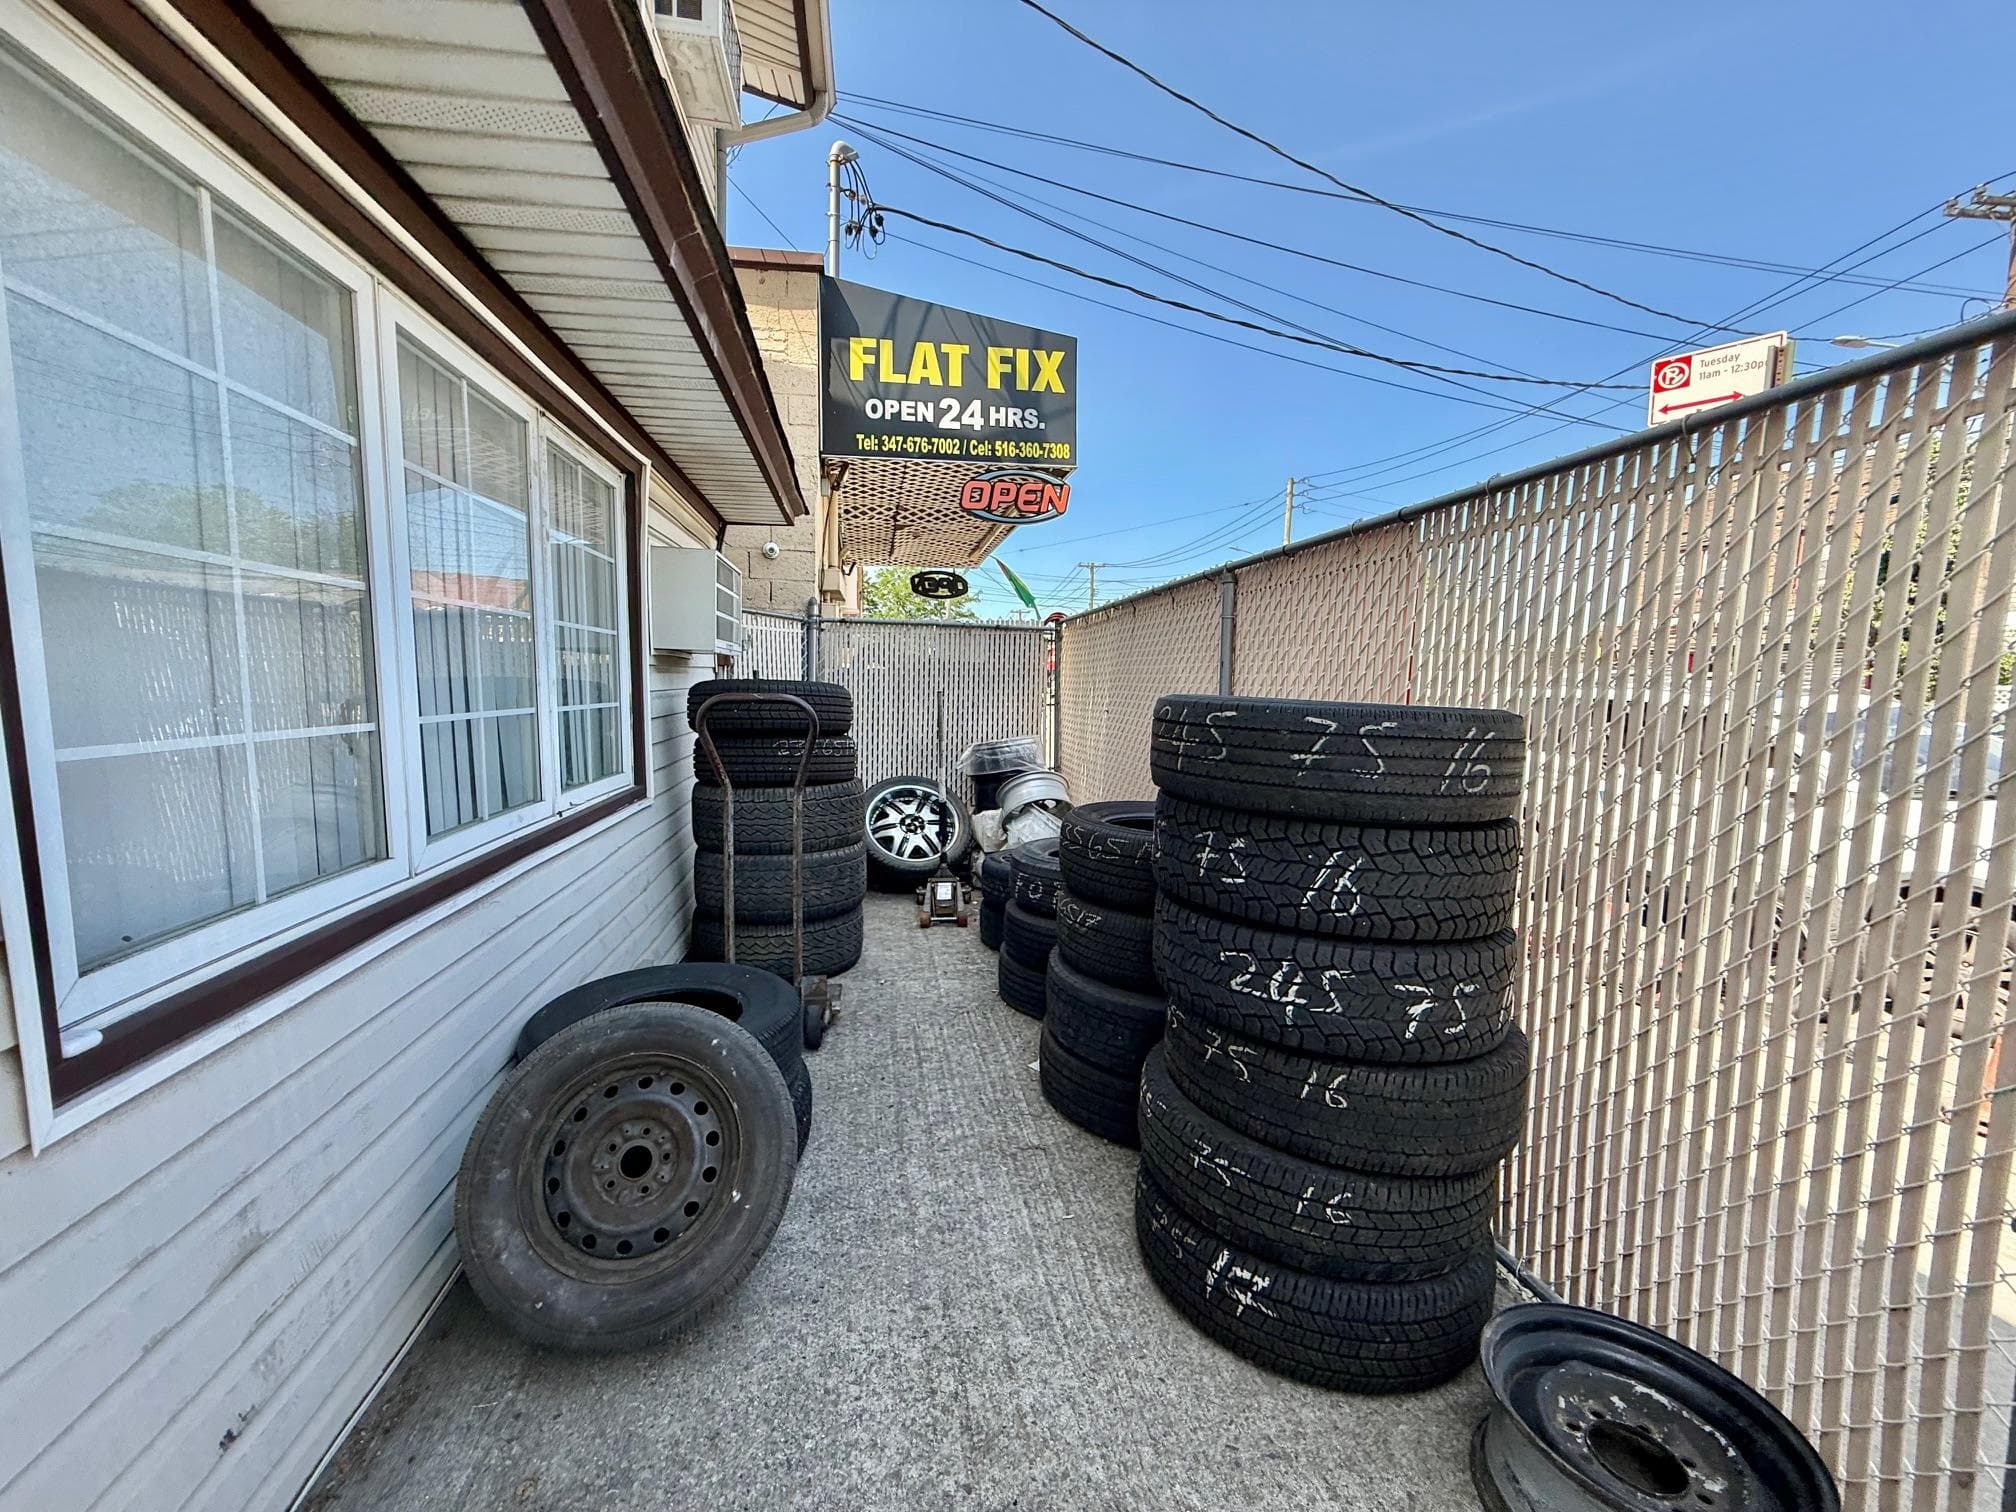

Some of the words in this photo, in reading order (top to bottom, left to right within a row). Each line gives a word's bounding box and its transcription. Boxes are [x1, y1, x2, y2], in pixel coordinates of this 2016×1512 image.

[849, 337, 970, 387] FLAT
[987, 346, 1066, 394] FIX
[1699, 370, 1721, 381] 11am
[1700, 353, 1741, 368] Tuesday
[865, 398, 934, 423] OPEN
[938, 397, 984, 431] 24
[989, 406, 1046, 430] HRS.
[856, 434, 878, 451] Tel:
[881, 435, 960, 455] 347-676-7002
[969, 440, 992, 456] Cel:
[995, 441, 1070, 459] 516-360-7308
[961, 480, 1070, 513] OPEN
[1290, 716, 1398, 780] 75
[1440, 726, 1496, 792] 16
[1220, 951, 1356, 1026] 245
[1394, 982, 1480, 1039] 75
[1203, 1028, 1259, 1083] 75
[1298, 1070, 1347, 1108] 16
[1296, 1184, 1352, 1224] 16
